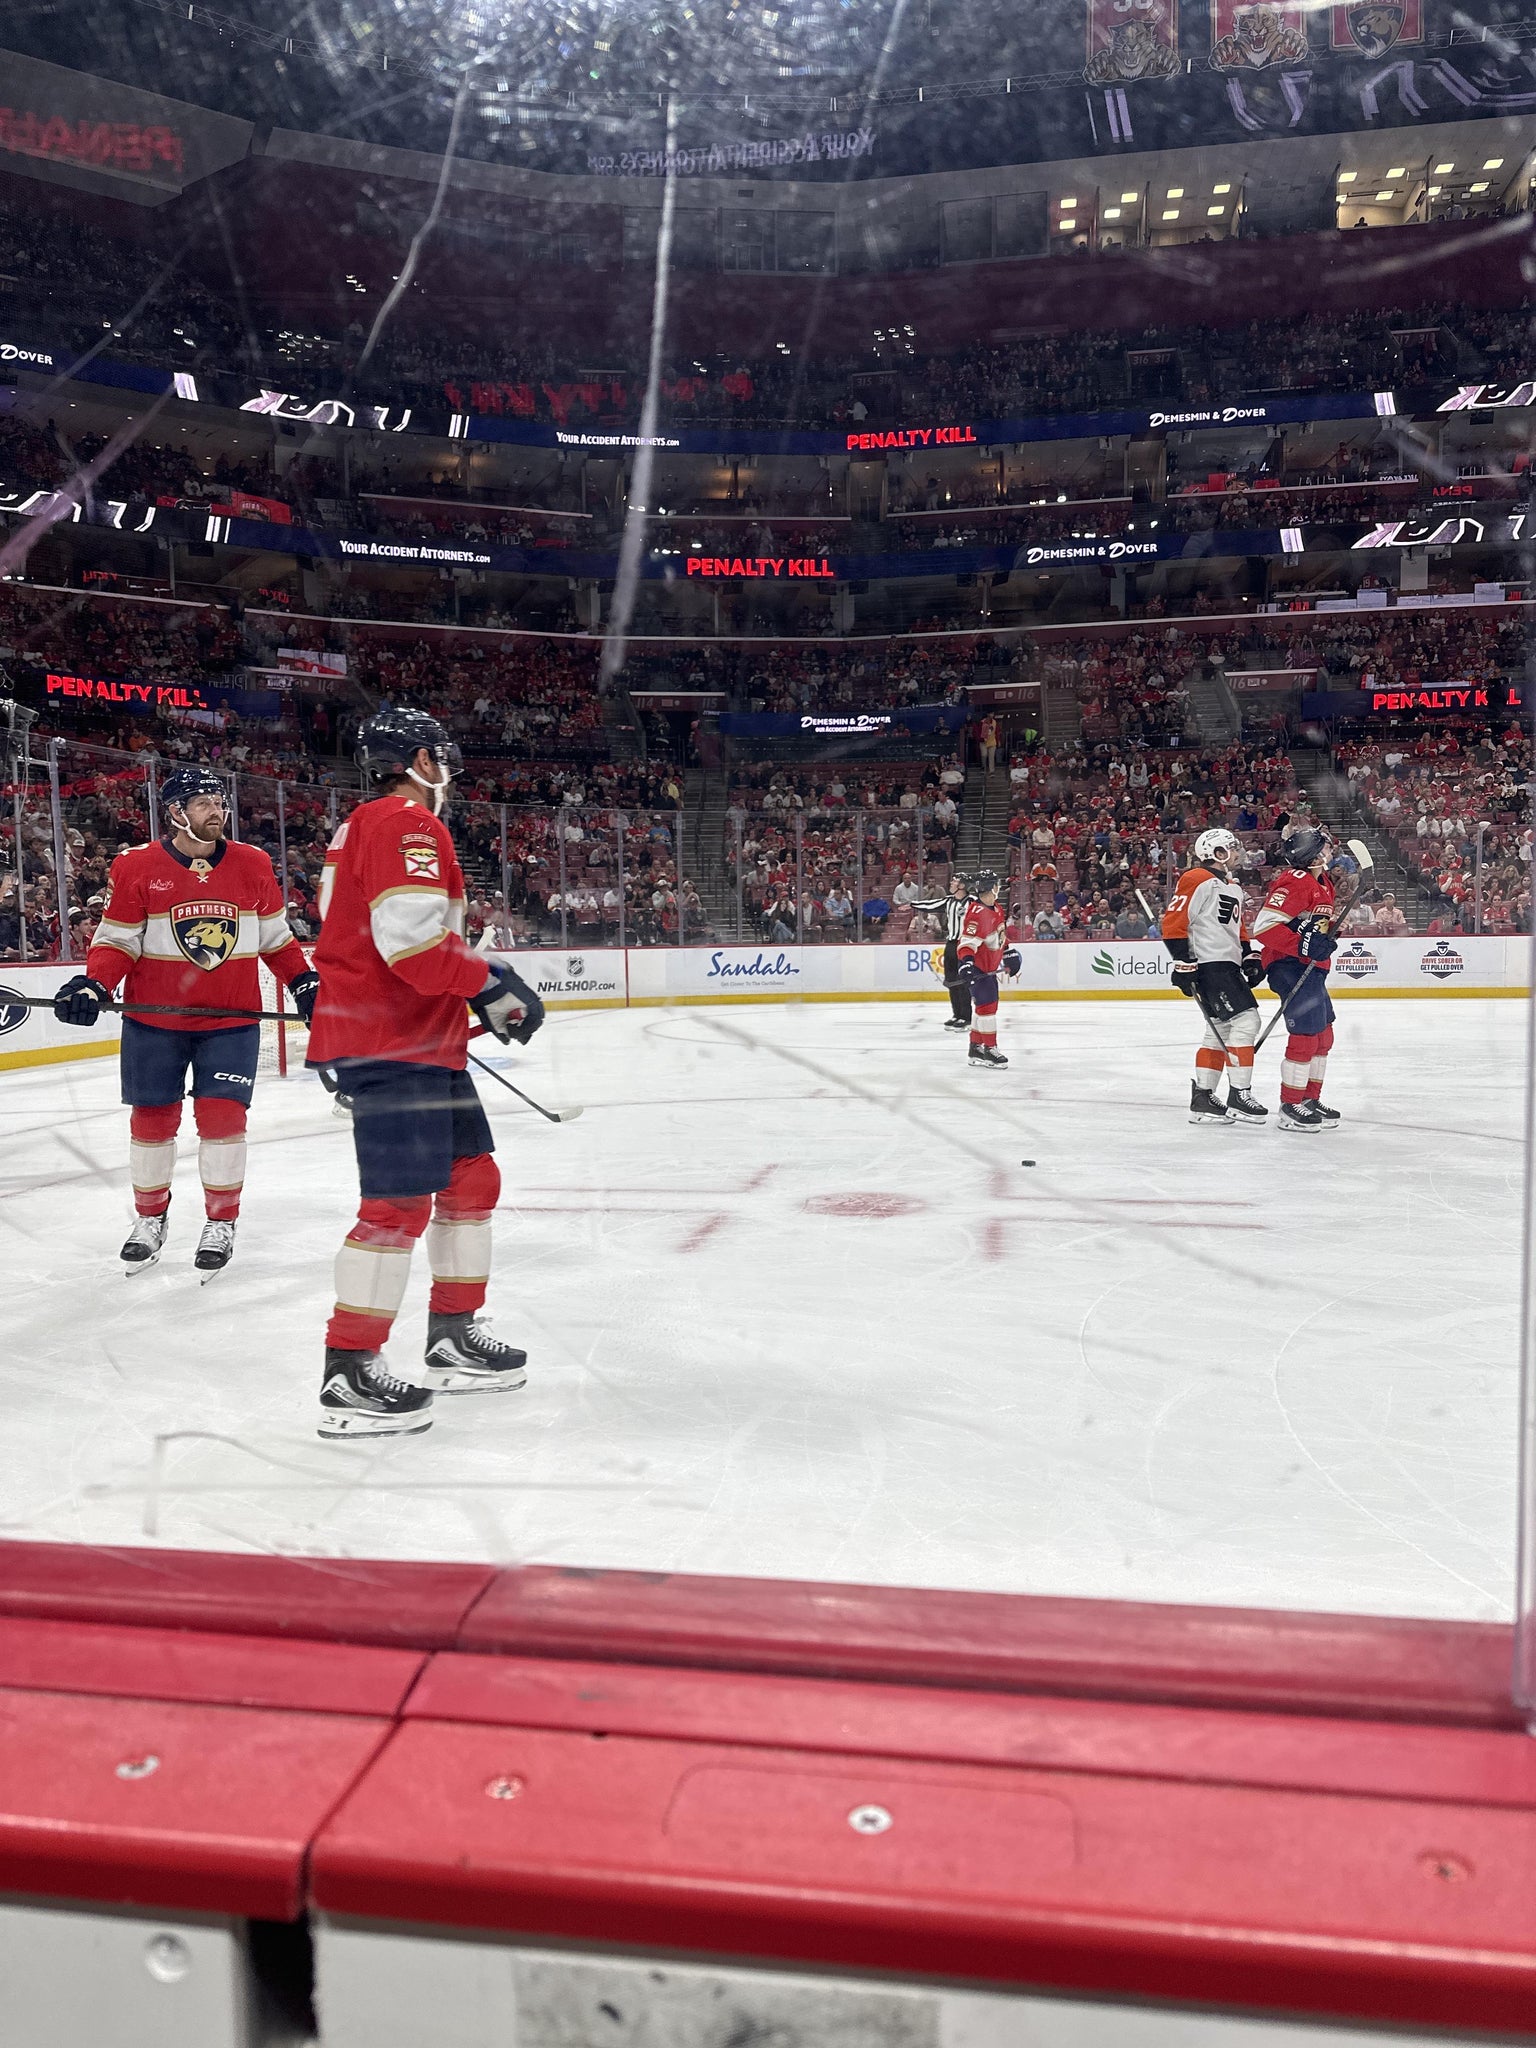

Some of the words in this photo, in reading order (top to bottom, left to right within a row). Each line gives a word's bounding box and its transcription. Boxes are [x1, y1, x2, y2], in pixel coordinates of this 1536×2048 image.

[0, 344, 53, 365] DOVER
[1149, 411, 1210, 428] DEMESMIN
[1212, 411, 1221, 421] &
[1222, 407, 1266, 422] DOVER
[556, 432, 579, 444] YOUR
[580, 434, 620, 445] ACCIDENT
[847, 428, 933, 450] PENALTY
[936, 426, 977, 445] KILL
[340, 540, 369, 555] YOUR
[370, 542, 419, 559] ACCIDENT
[1026, 547, 1096, 564] DEMESMIN
[1098, 546, 1106, 556] &
[1109, 542, 1158, 559] DOVER
[687, 557, 785, 577] PENALTY
[788, 558, 834, 577] KILL
[46, 674, 153, 702] PENALTY
[1373, 690, 1471, 711] PENALTY
[1475, 688, 1522, 707] KL
[849, 717, 856, 725] &
[177, 904, 234, 919] PANTHERS
[971, 905, 984, 914] 17
[1167, 895, 1188, 912] 27
[707, 951, 800, 977] Sandals
[213, 1072, 253, 1087] CCM
